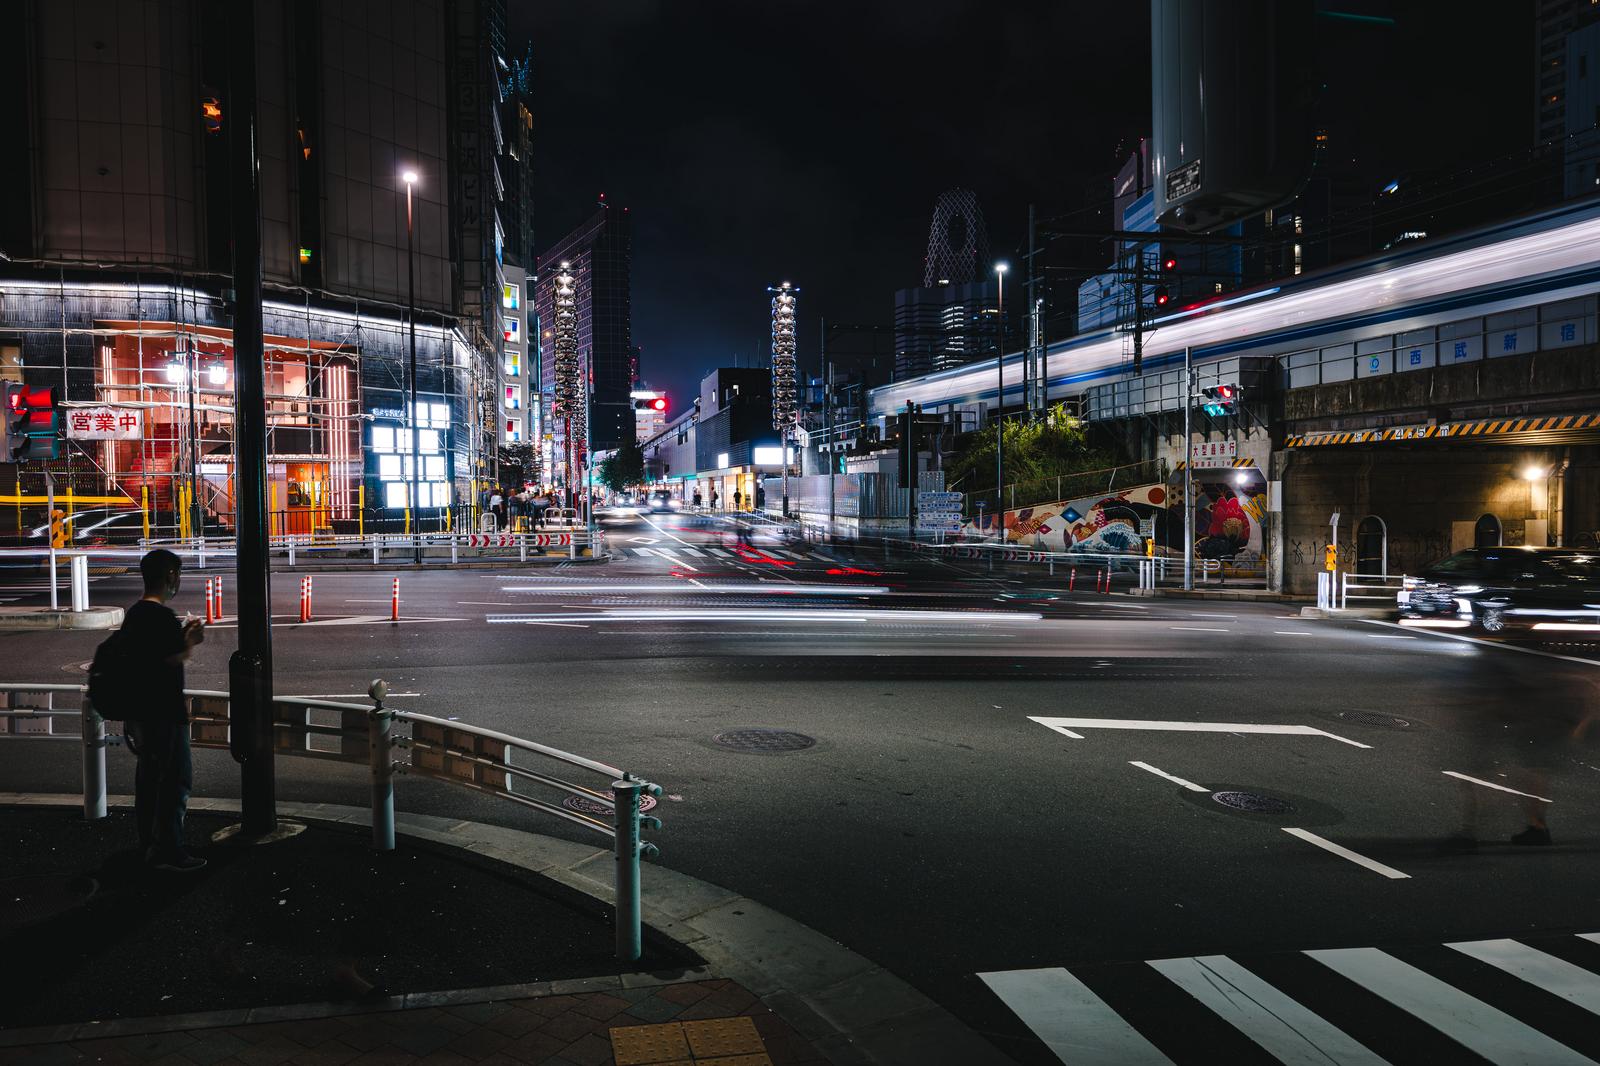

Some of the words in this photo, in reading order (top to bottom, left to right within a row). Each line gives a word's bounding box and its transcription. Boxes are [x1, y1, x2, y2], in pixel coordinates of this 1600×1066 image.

[1410, 323, 1576, 366] 西武新宿
[71, 412, 137, 432] 営業中
